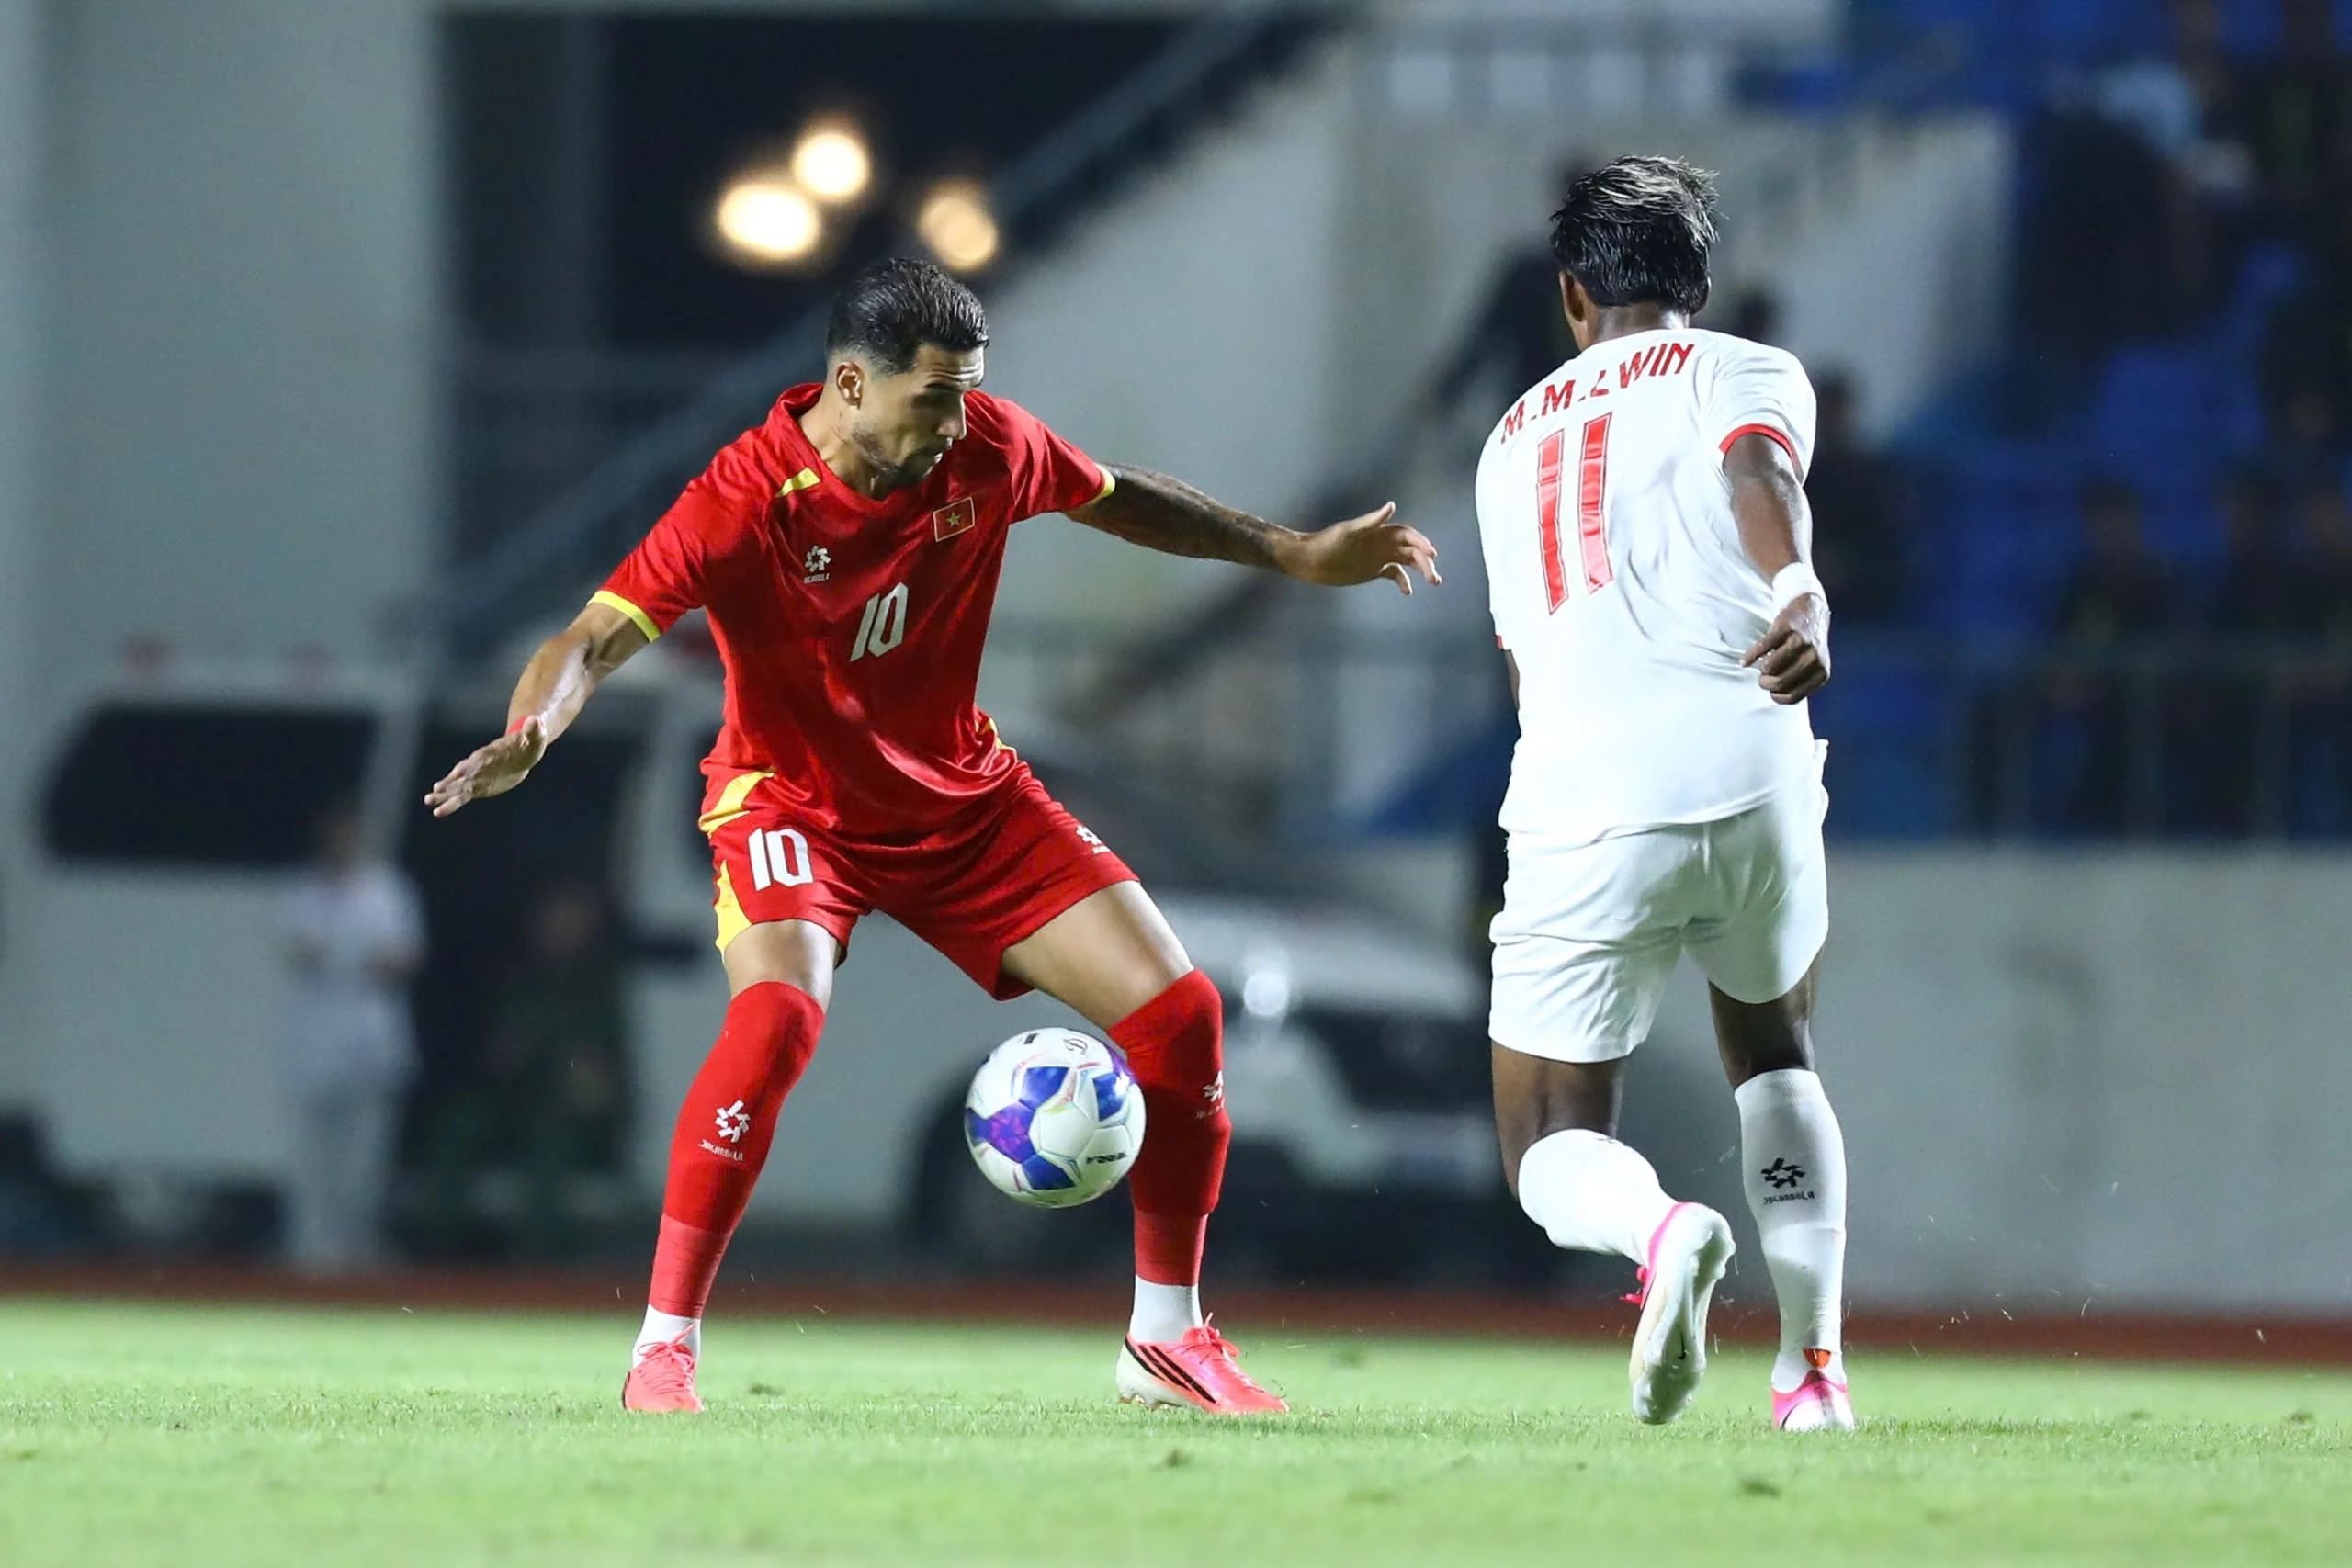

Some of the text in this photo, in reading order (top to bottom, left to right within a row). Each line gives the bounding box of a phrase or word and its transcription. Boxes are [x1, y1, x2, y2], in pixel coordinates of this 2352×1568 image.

[1536, 411, 1614, 616] 11
[850, 581, 909, 662] 10
[748, 827, 814, 892] 10
